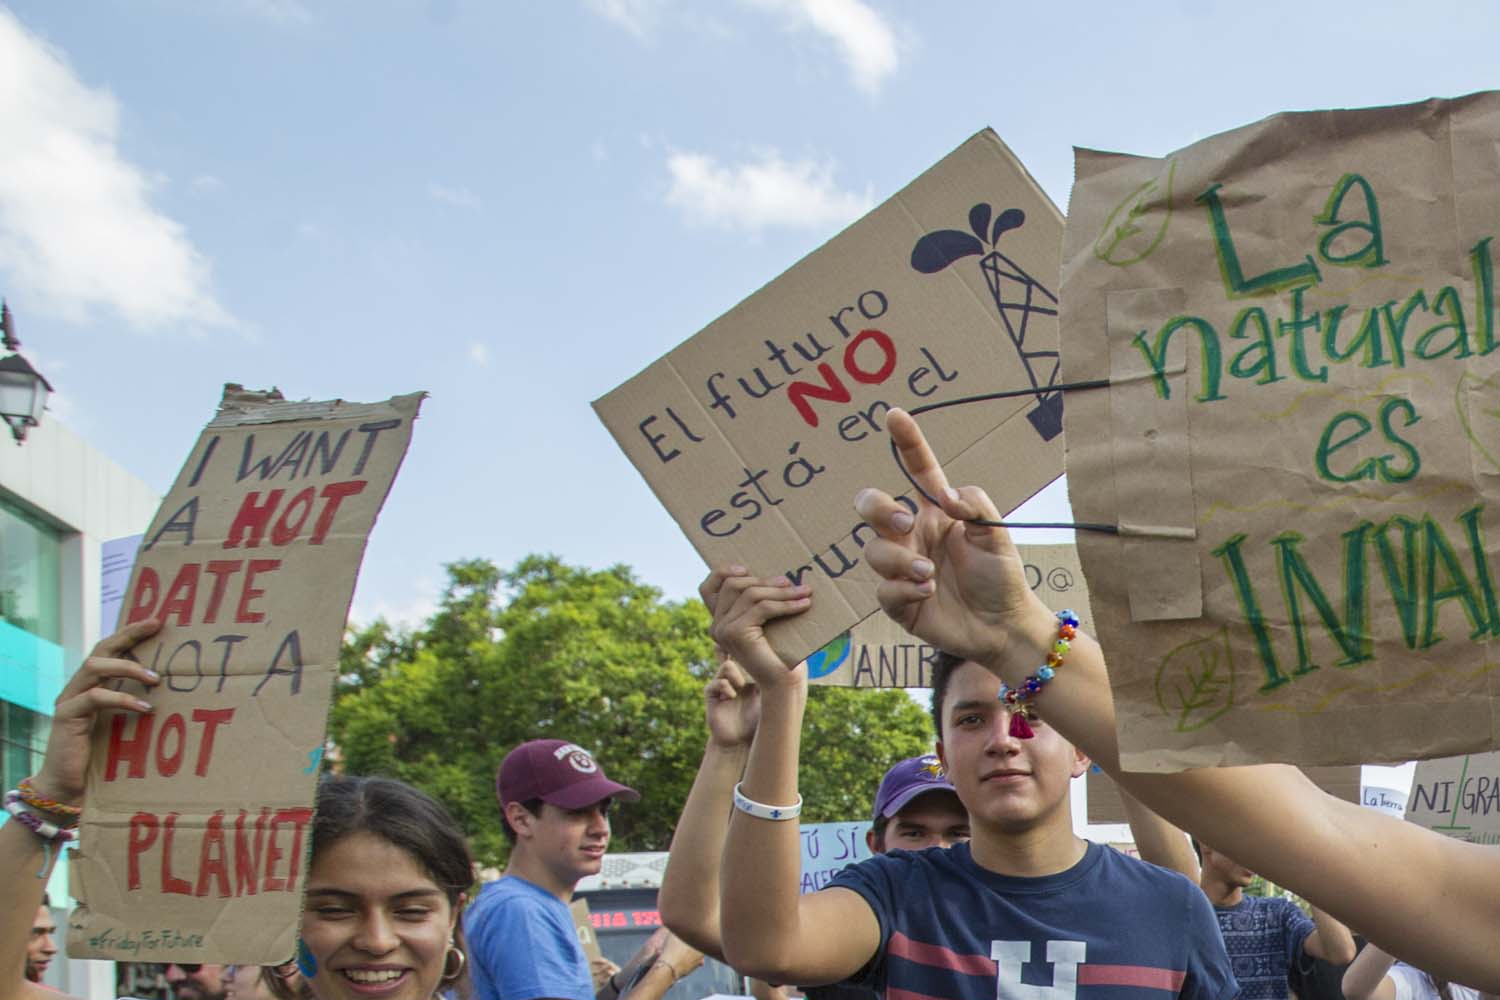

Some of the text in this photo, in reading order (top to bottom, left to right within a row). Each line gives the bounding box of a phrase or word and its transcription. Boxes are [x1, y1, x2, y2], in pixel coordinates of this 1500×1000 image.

[1200, 173, 1390, 300] La
[639, 289, 890, 464] El futuro
[787, 328, 897, 428] NO
[188, 419, 402, 488] I WANT
[700, 346, 959, 538] está en el
[1315, 396, 1422, 484] es
[142, 480, 368, 553] A HOT
[252, 629, 304, 697] A
[104, 708, 236, 782] HOT
[1412, 781, 1455, 814] NI
[128, 807, 314, 898] PLANET
